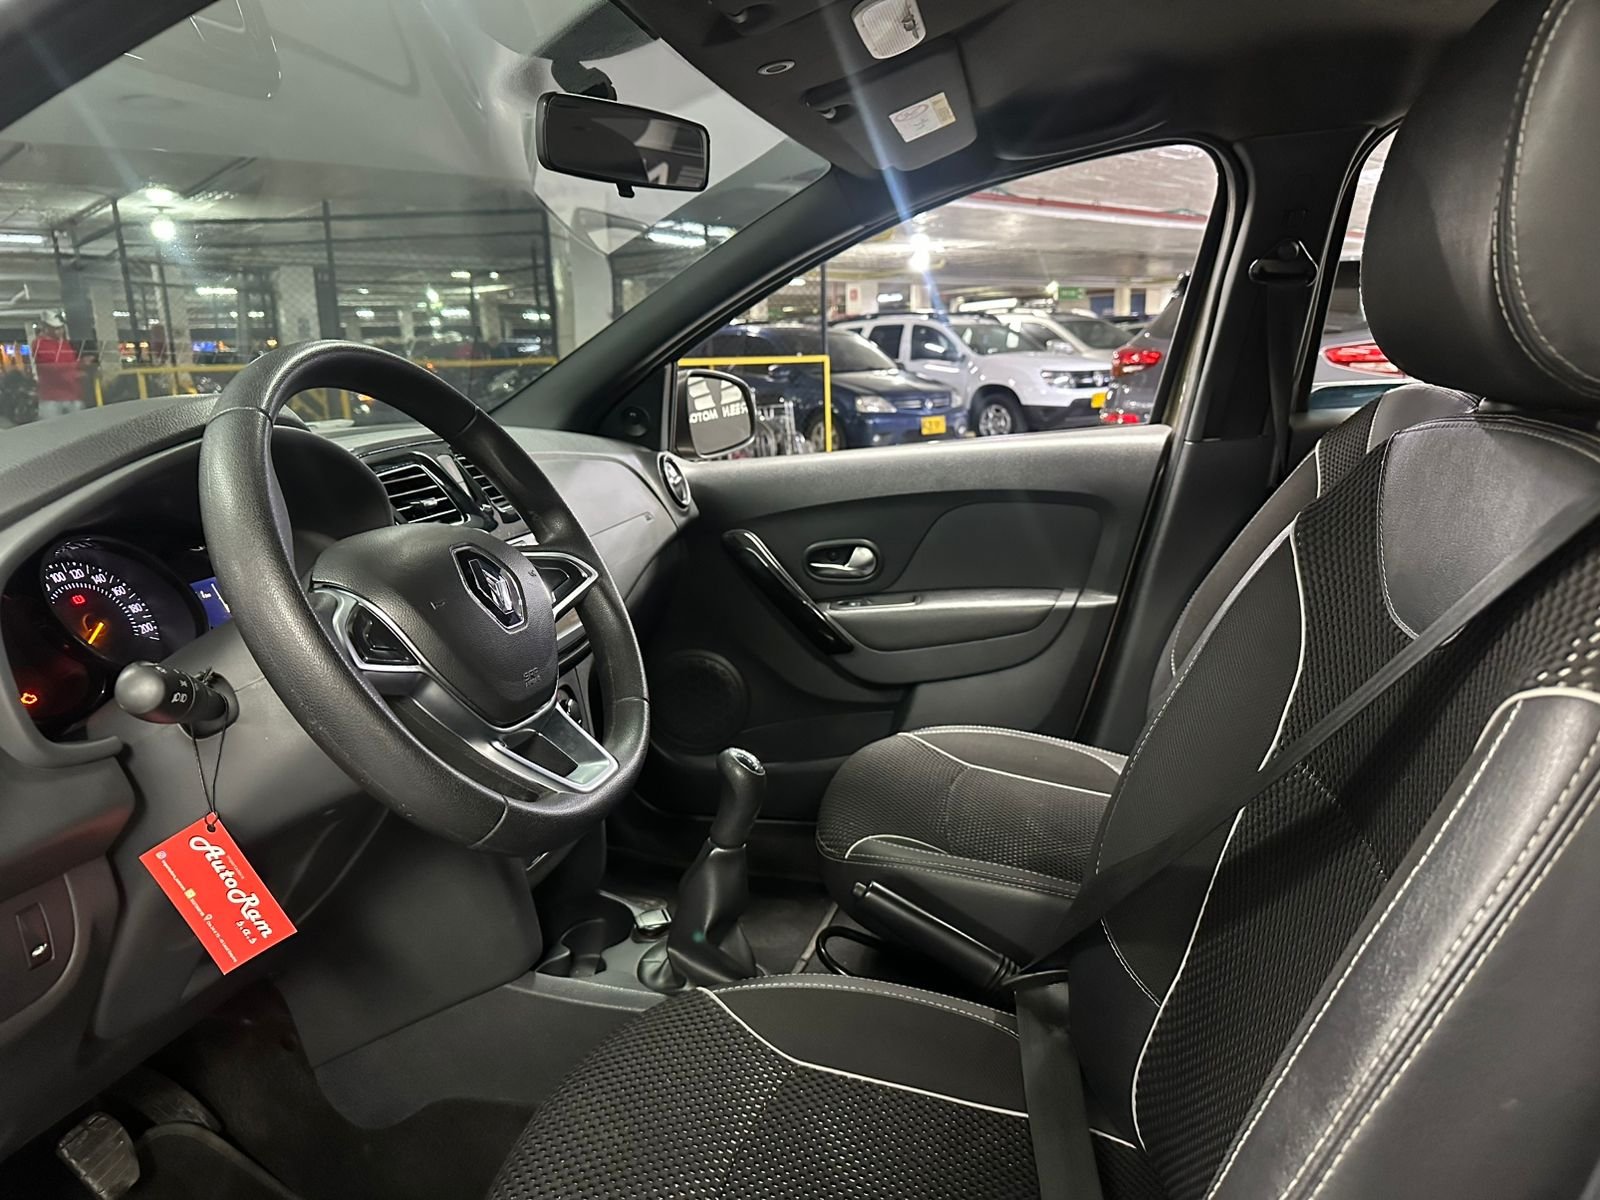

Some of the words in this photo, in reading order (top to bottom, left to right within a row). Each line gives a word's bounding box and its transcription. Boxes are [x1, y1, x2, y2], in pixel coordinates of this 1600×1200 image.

[49, 571, 67, 584] 100
[69, 568, 85, 580] 120
[91, 573, 107, 585] 140
[111, 585, 127, 597] 160
[128, 602, 143, 614] 180
[137, 622, 154, 635] 200
